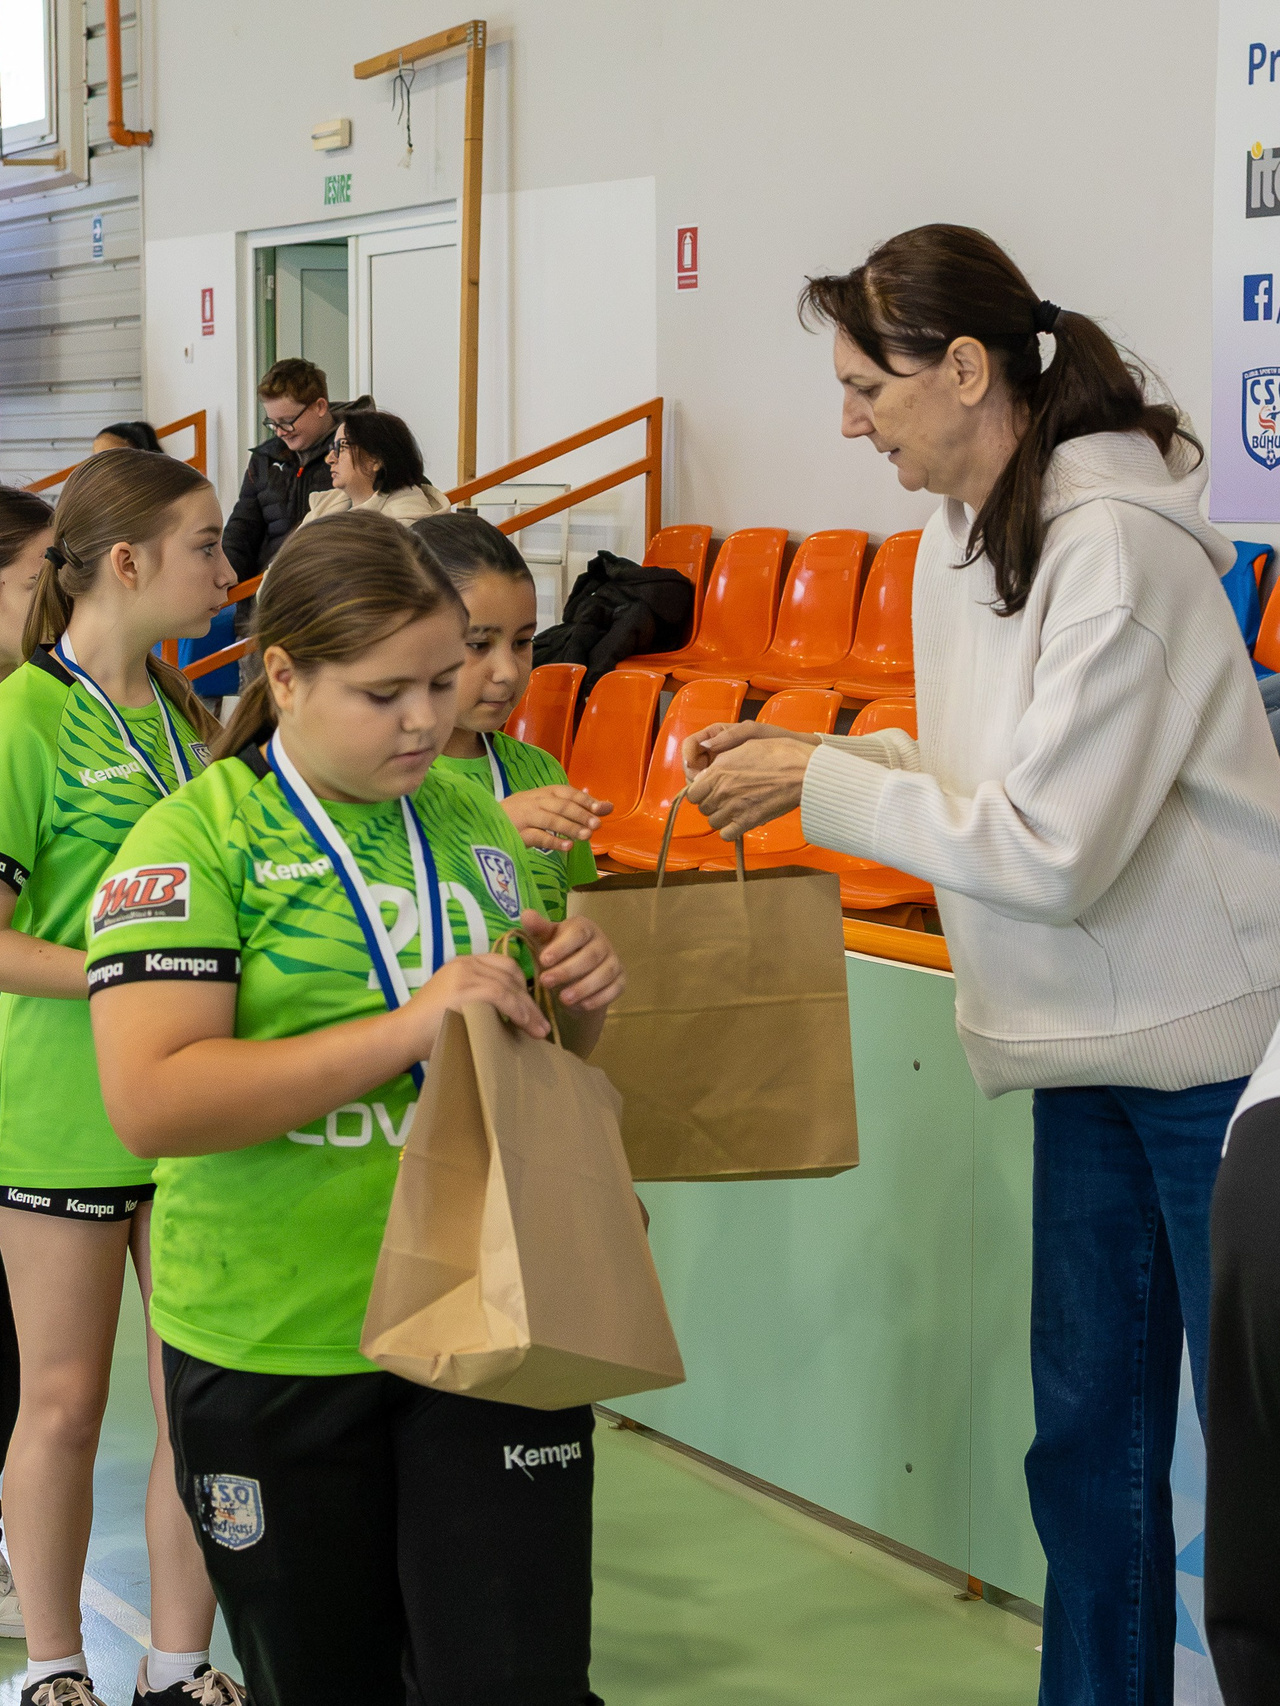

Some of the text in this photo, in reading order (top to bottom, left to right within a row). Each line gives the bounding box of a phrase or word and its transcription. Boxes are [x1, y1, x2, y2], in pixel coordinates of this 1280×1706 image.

[1250, 378, 1280, 406] CS
[79, 760, 141, 786] Kempa
[254, 857, 331, 884] Kemp
[145, 953, 219, 977] Kempa
[8, 1188, 51, 1208] Kempa
[66, 1199, 114, 1217] Kempa
[504, 1439, 581, 1470] Kempa
[209, 1485, 250, 1504] SO
